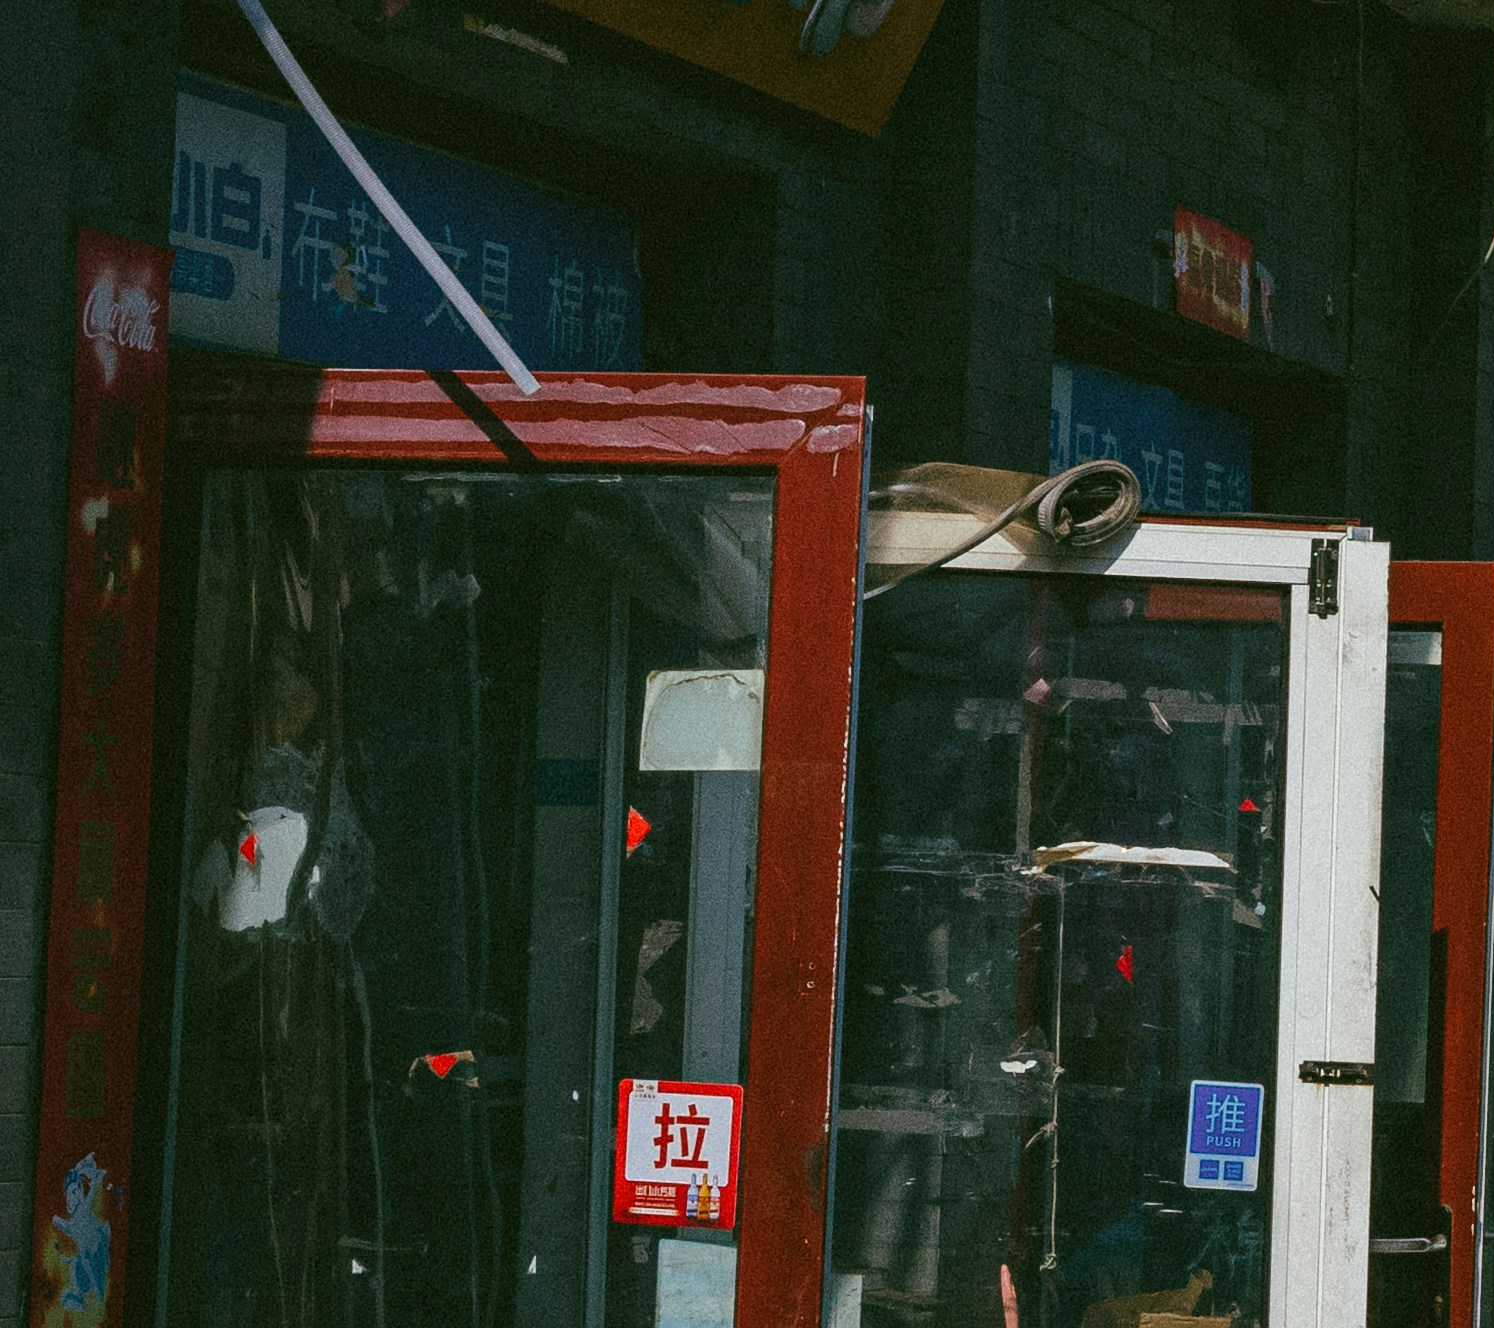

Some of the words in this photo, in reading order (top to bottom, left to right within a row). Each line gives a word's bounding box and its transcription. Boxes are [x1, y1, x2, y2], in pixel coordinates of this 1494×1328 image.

[1206, 1093, 1246, 1134] 推
[653, 1102, 710, 1169] 拉
[1206, 1136, 1242, 1148] PUSH
